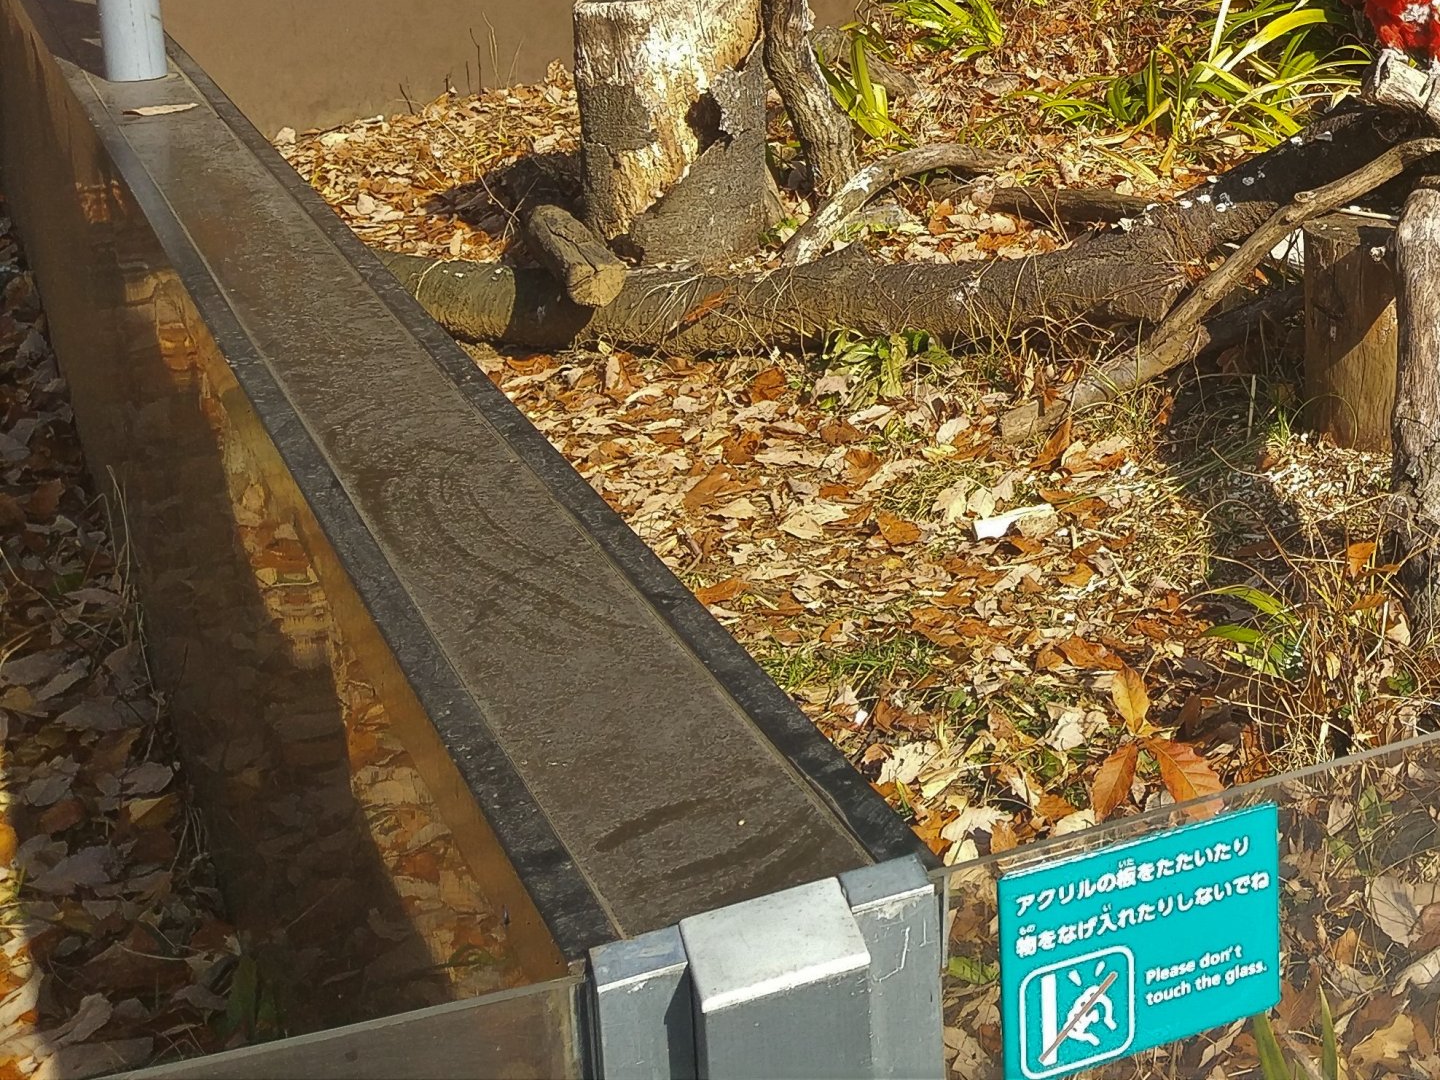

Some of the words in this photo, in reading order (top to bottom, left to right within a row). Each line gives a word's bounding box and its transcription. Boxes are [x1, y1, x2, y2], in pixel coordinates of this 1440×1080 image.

[1015, 836, 1249, 917] アクリルの板をたたいたり
[1015, 871, 1270, 958] 物をなげ入れたりしないでね
[1145, 960, 1196, 985] Please
[1199, 945, 1243, 970] don't
[1145, 981, 1192, 1006] touch
[1195, 972, 1222, 992] the
[1225, 962, 1268, 985] glass.
